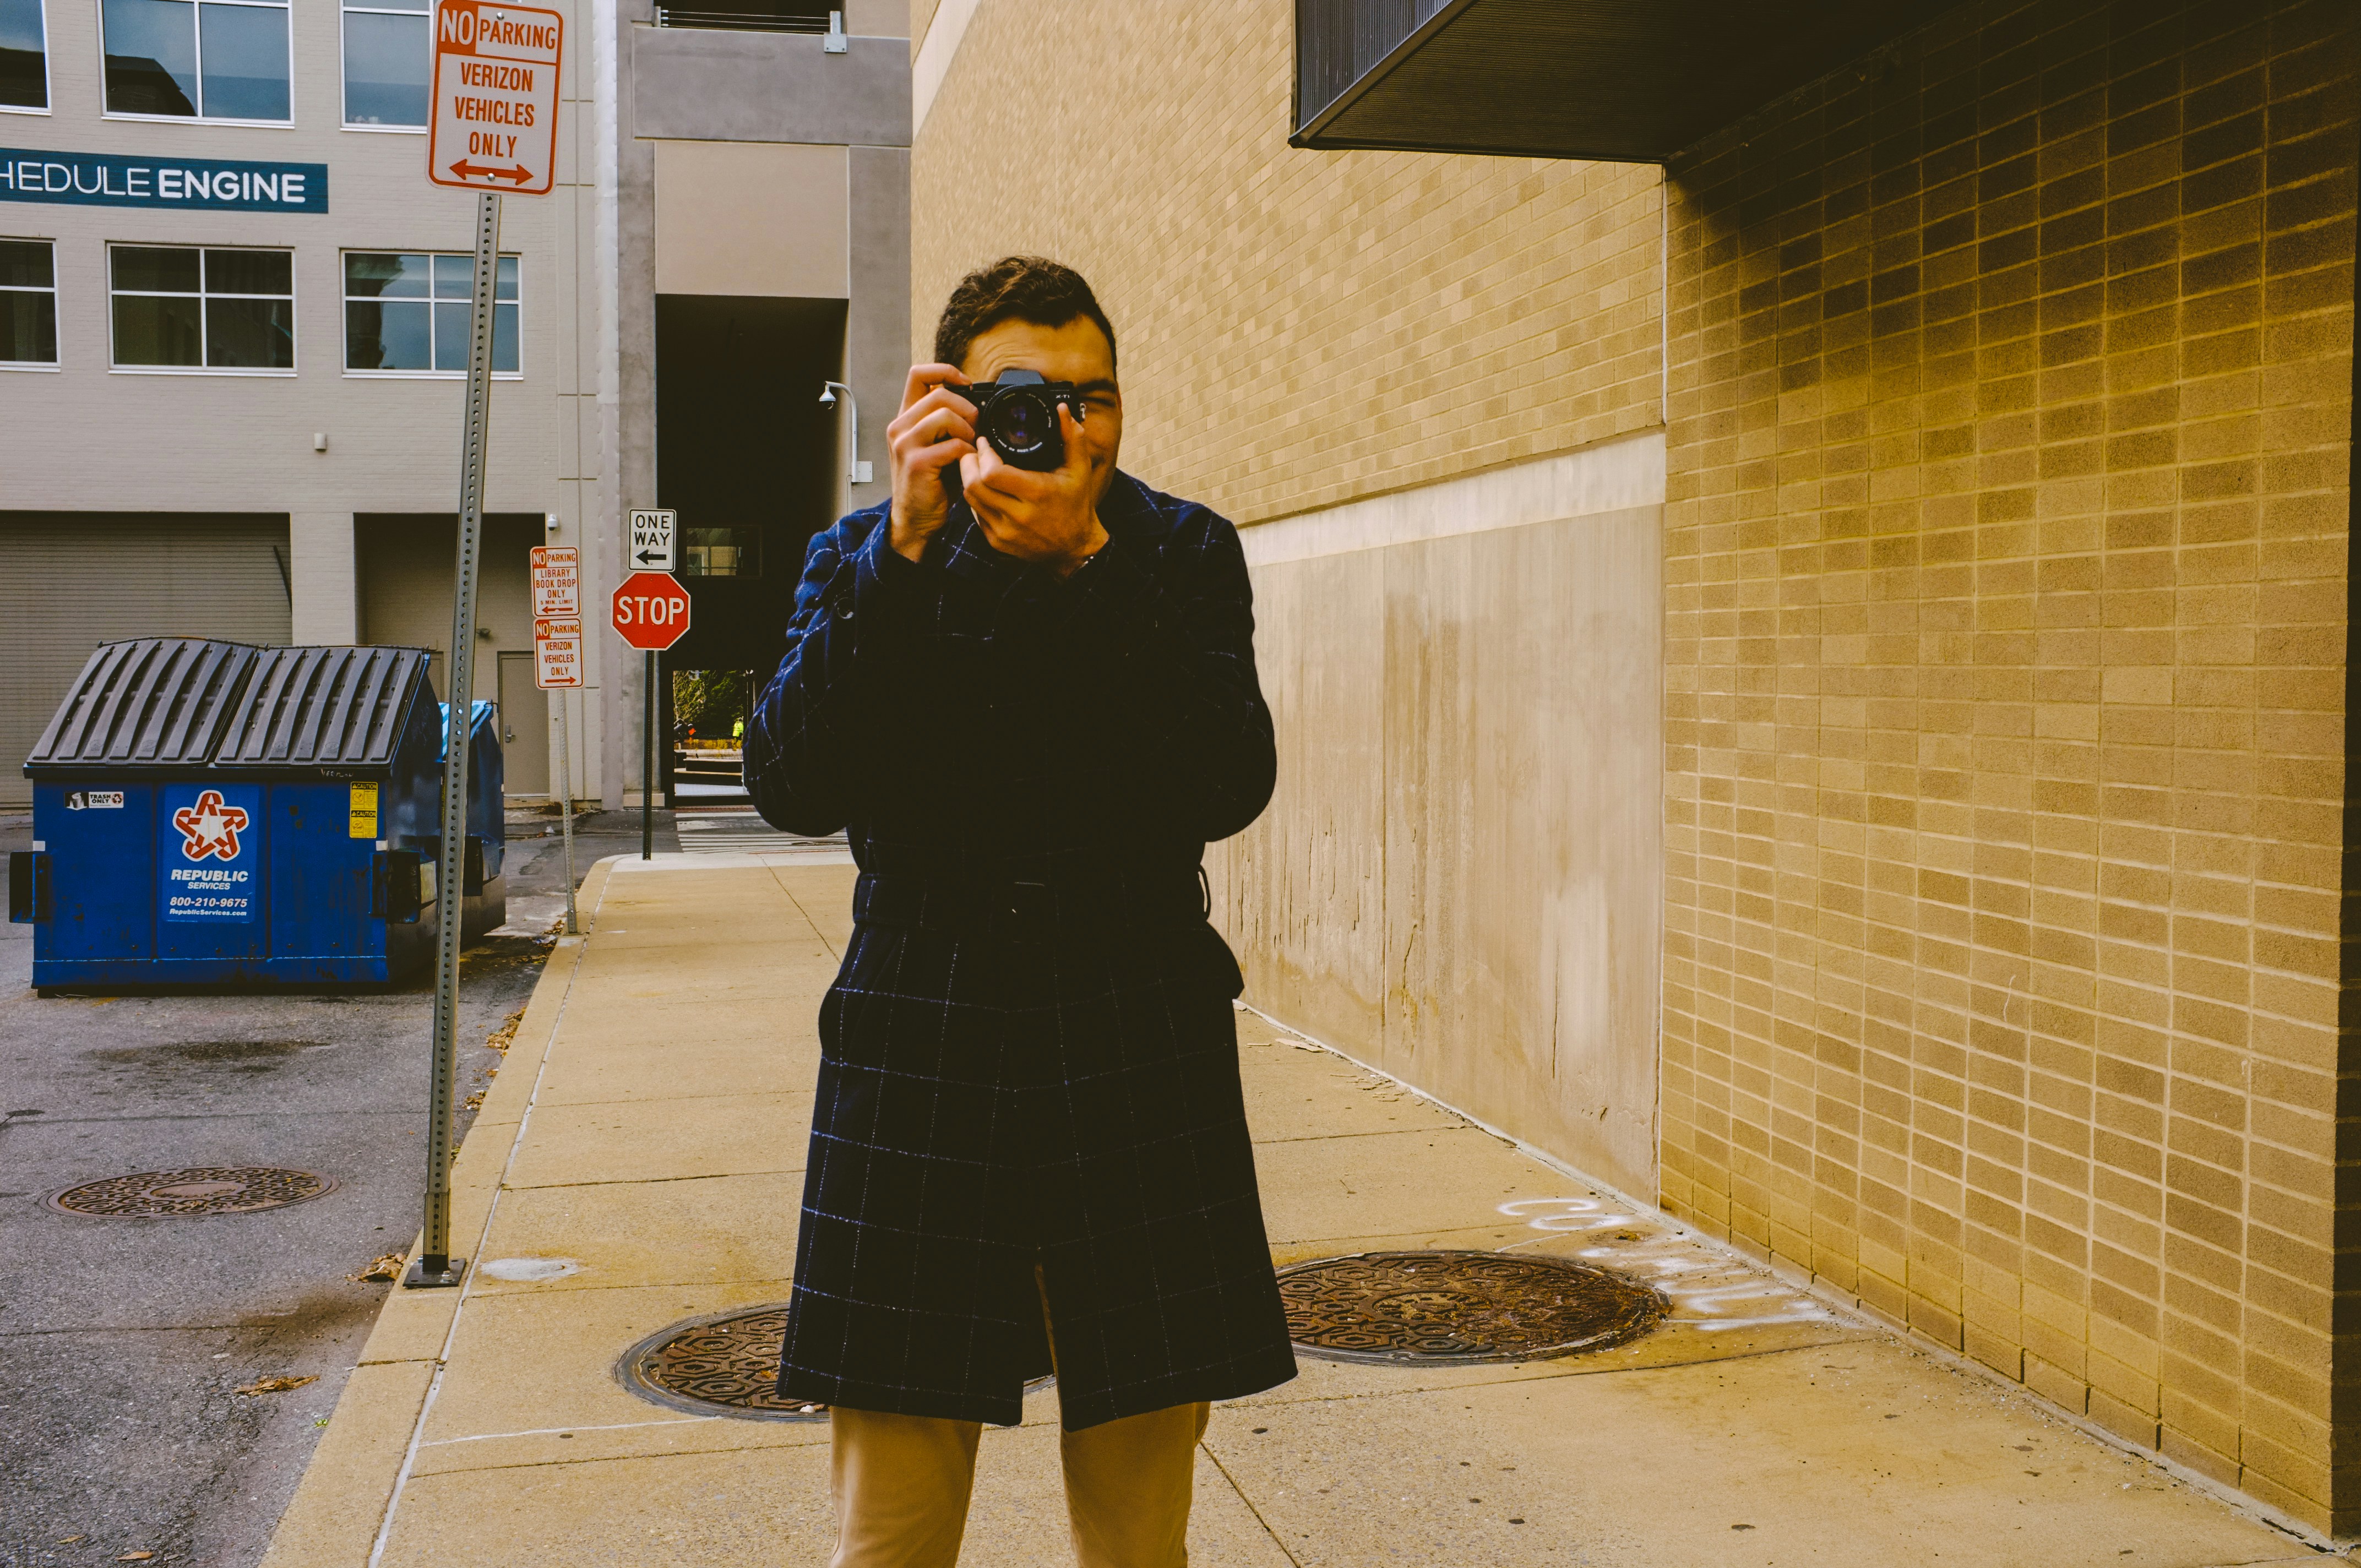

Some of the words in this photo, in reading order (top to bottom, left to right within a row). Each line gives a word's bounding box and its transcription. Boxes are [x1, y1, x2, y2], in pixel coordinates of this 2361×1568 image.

[440, 8, 475, 45] NO
[480, 19, 556, 50] PARKING
[461, 62, 533, 92] VERIZON
[455, 96, 535, 127] VEHICLES
[469, 131, 517, 158] ONLY
[159, 169, 306, 203] ENGINE
[635, 514, 670, 529] ONE
[635, 532, 671, 546] WAY
[533, 552, 545, 565] NO
[547, 553, 576, 562] PARKING
[541, 569, 570, 578] LIBRARY
[536, 579, 554, 588] BOOK
[557, 579, 576, 587] DROP
[547, 590, 565, 598] ONLY
[617, 596, 684, 625] STOP
[536, 623, 549, 636] NO
[551, 624, 579, 634] PARKING
[545, 641, 572, 650] VERIZON
[545, 654, 574, 663] VEHICLES
[551, 667, 569, 676] ONLY
[171, 869, 248, 882] REPUBLIC
[170, 896, 248, 907] 800-210-9675
